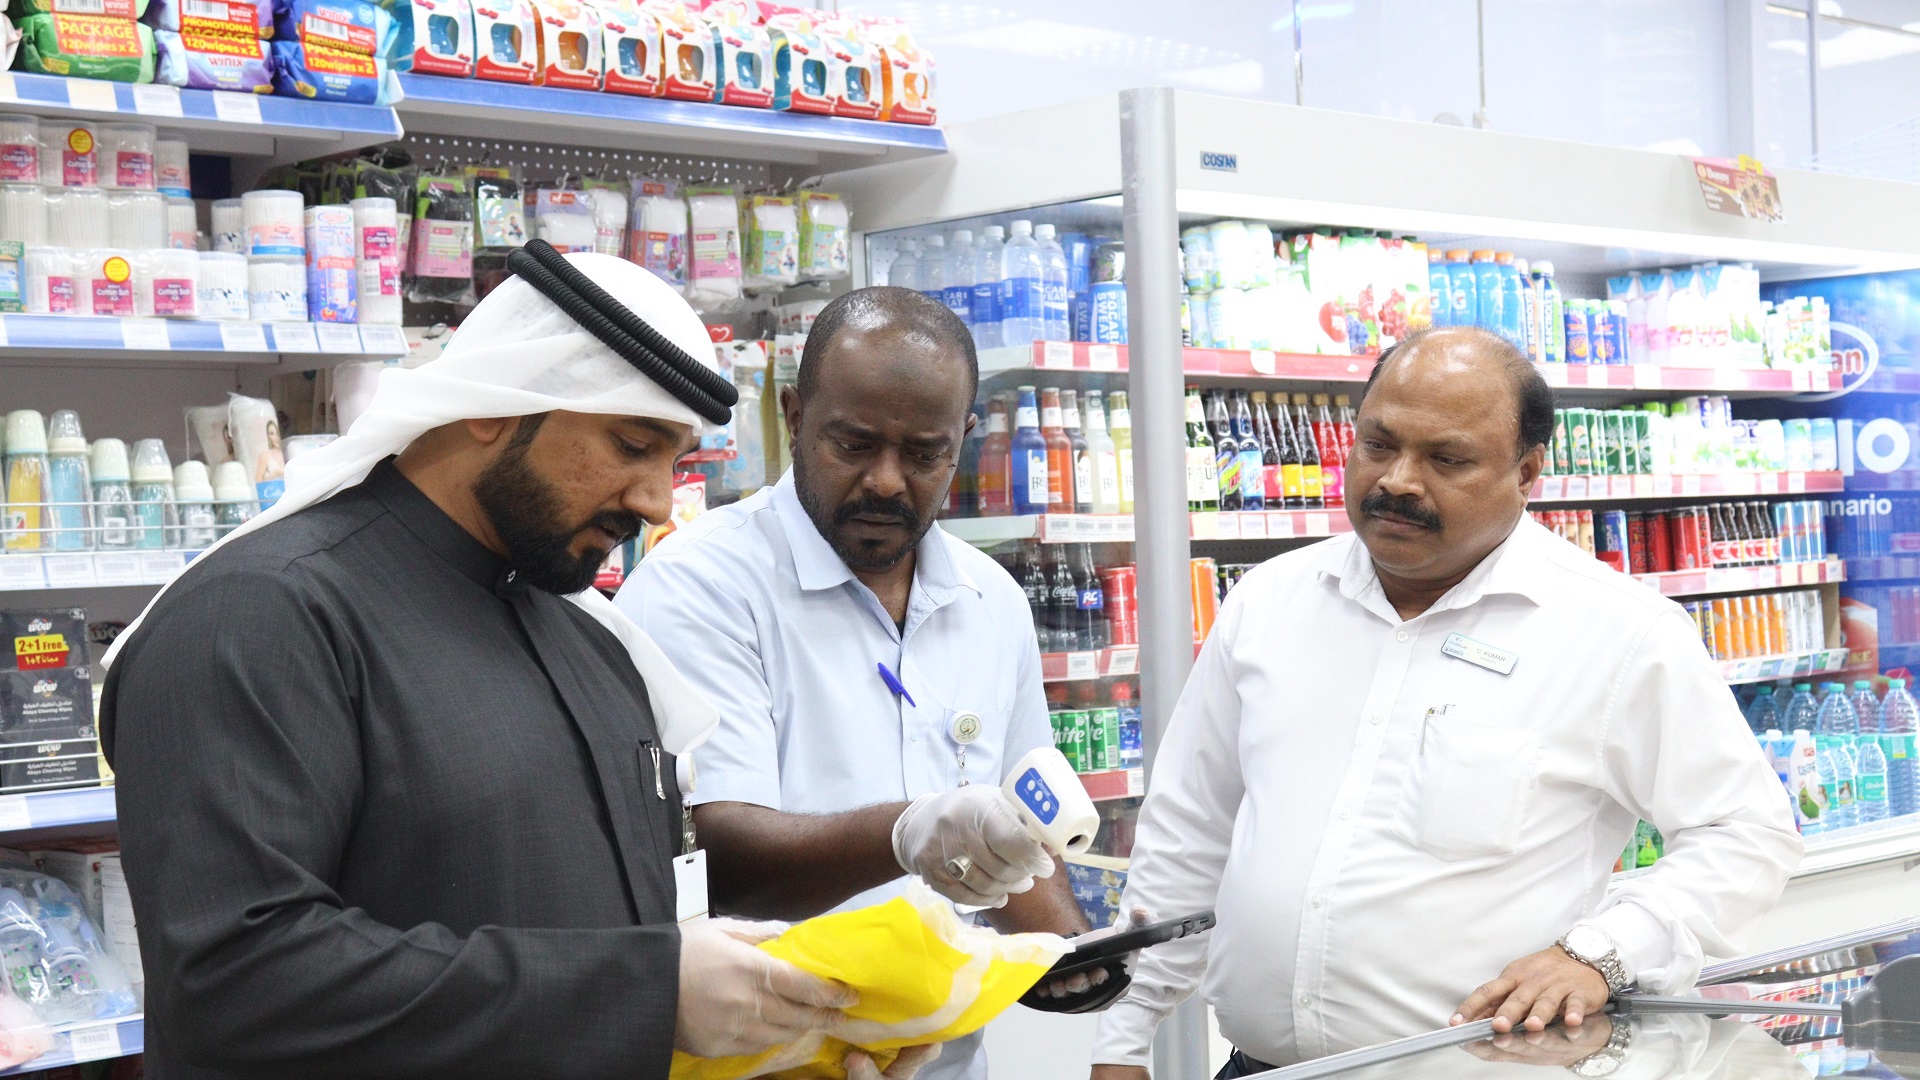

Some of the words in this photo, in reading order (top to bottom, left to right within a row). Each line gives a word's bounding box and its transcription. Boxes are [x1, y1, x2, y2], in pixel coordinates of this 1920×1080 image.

[60, 22, 135, 39] PACKAGE
[183, 17, 254, 33] PROMOTIONAL
[62, 38, 117, 52] 120wipes
[127, 41, 137, 53] 2
[185, 37, 240, 53] 120wipes
[248, 45, 259, 57] 2
[308, 57, 356, 72] 120wipes
[364, 62, 375, 75] 2
[1203, 153, 1237, 169] COSTAN
[1078, 301, 1088, 341] SWEA
[1097, 292, 1110, 341] SWEAT
[1831, 350, 1862, 374] an
[1083, 591, 1098, 604] RC
[19, 639, 40, 652] 2+1
[43, 641, 62, 651] Free
[1483, 651, 1506, 662] KUMAR
